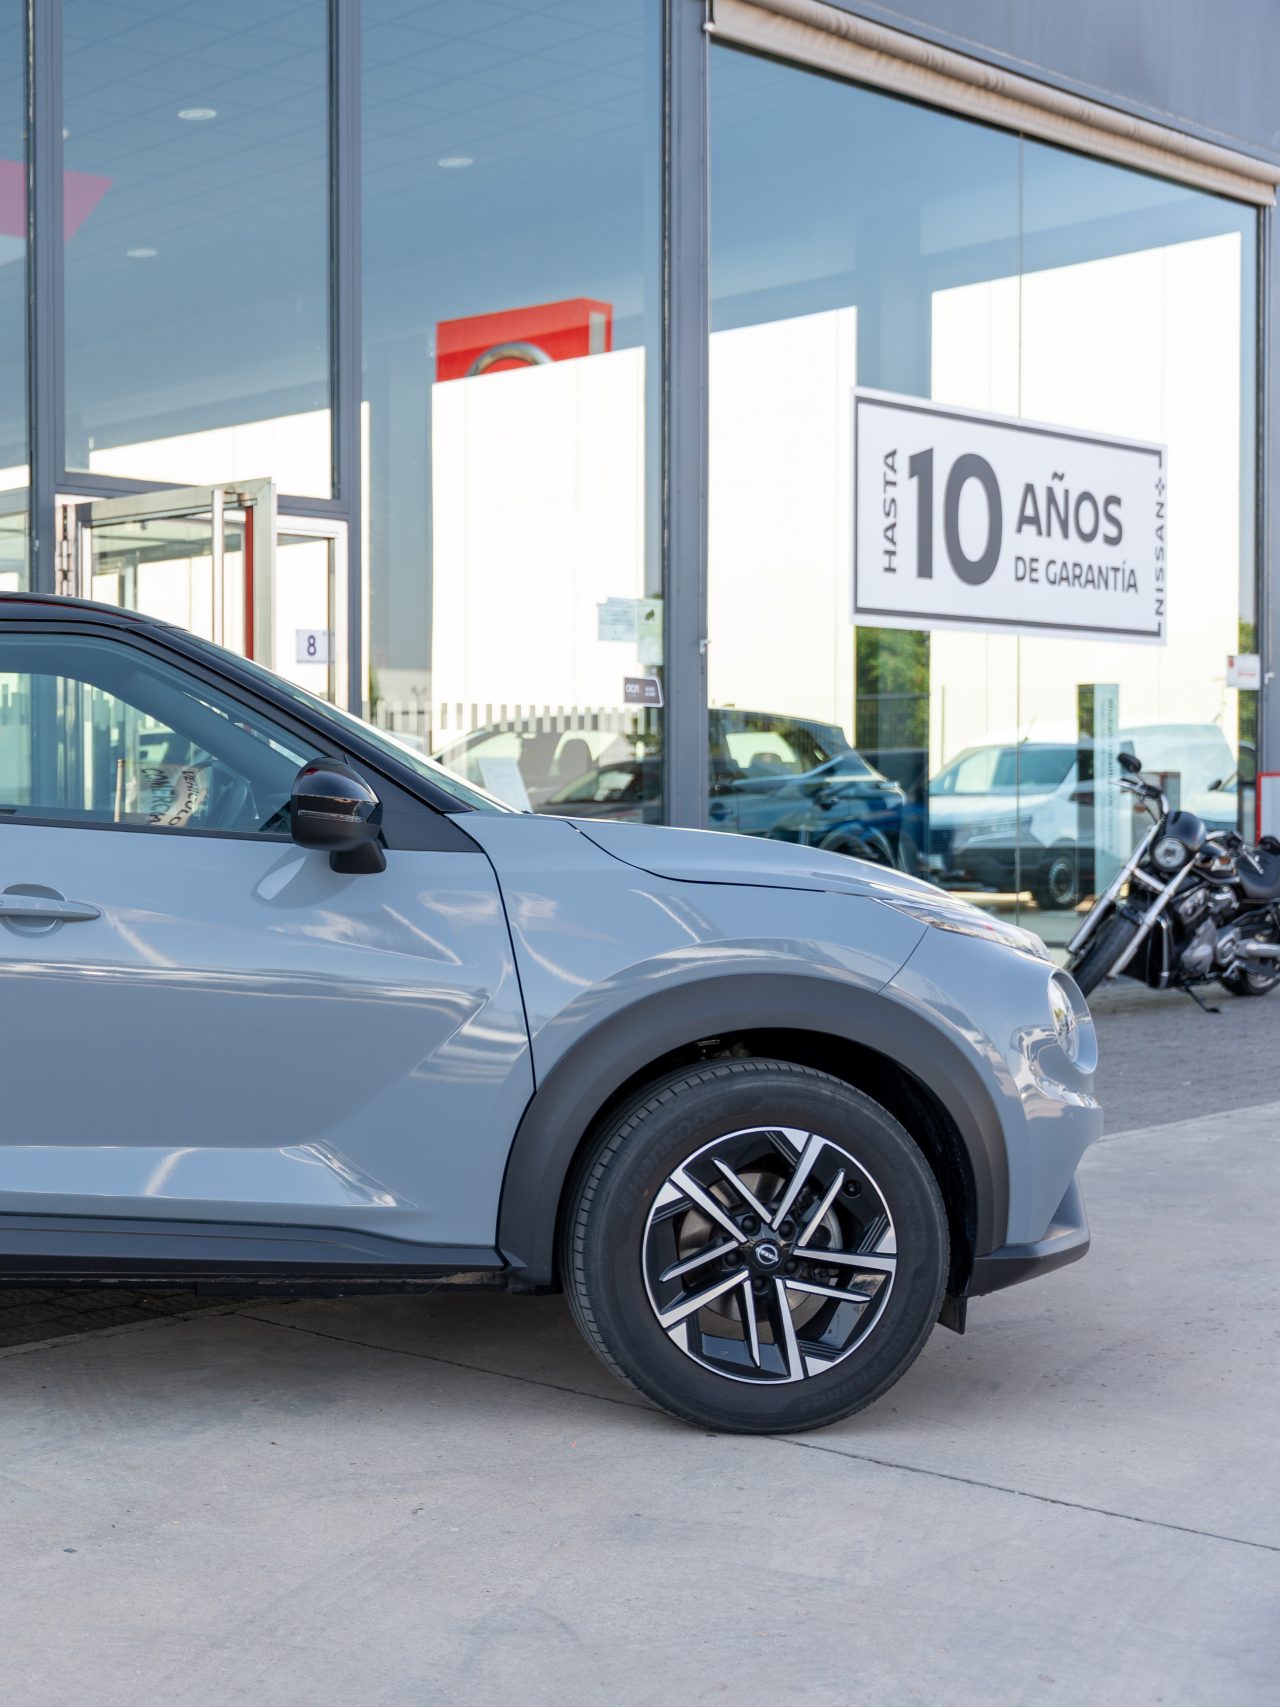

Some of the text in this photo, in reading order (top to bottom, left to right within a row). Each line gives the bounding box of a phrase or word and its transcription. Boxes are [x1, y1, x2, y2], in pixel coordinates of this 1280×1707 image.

[883, 448, 897, 574] HASTA
[908, 447, 1123, 587] 10 AÑOS
[1014, 556, 1139, 594] DE GARANTÍA
[1155, 501, 1165, 617] NISSAN
[307, 634, 317, 657] 8
[141, 768, 175, 824] COMERCIA
